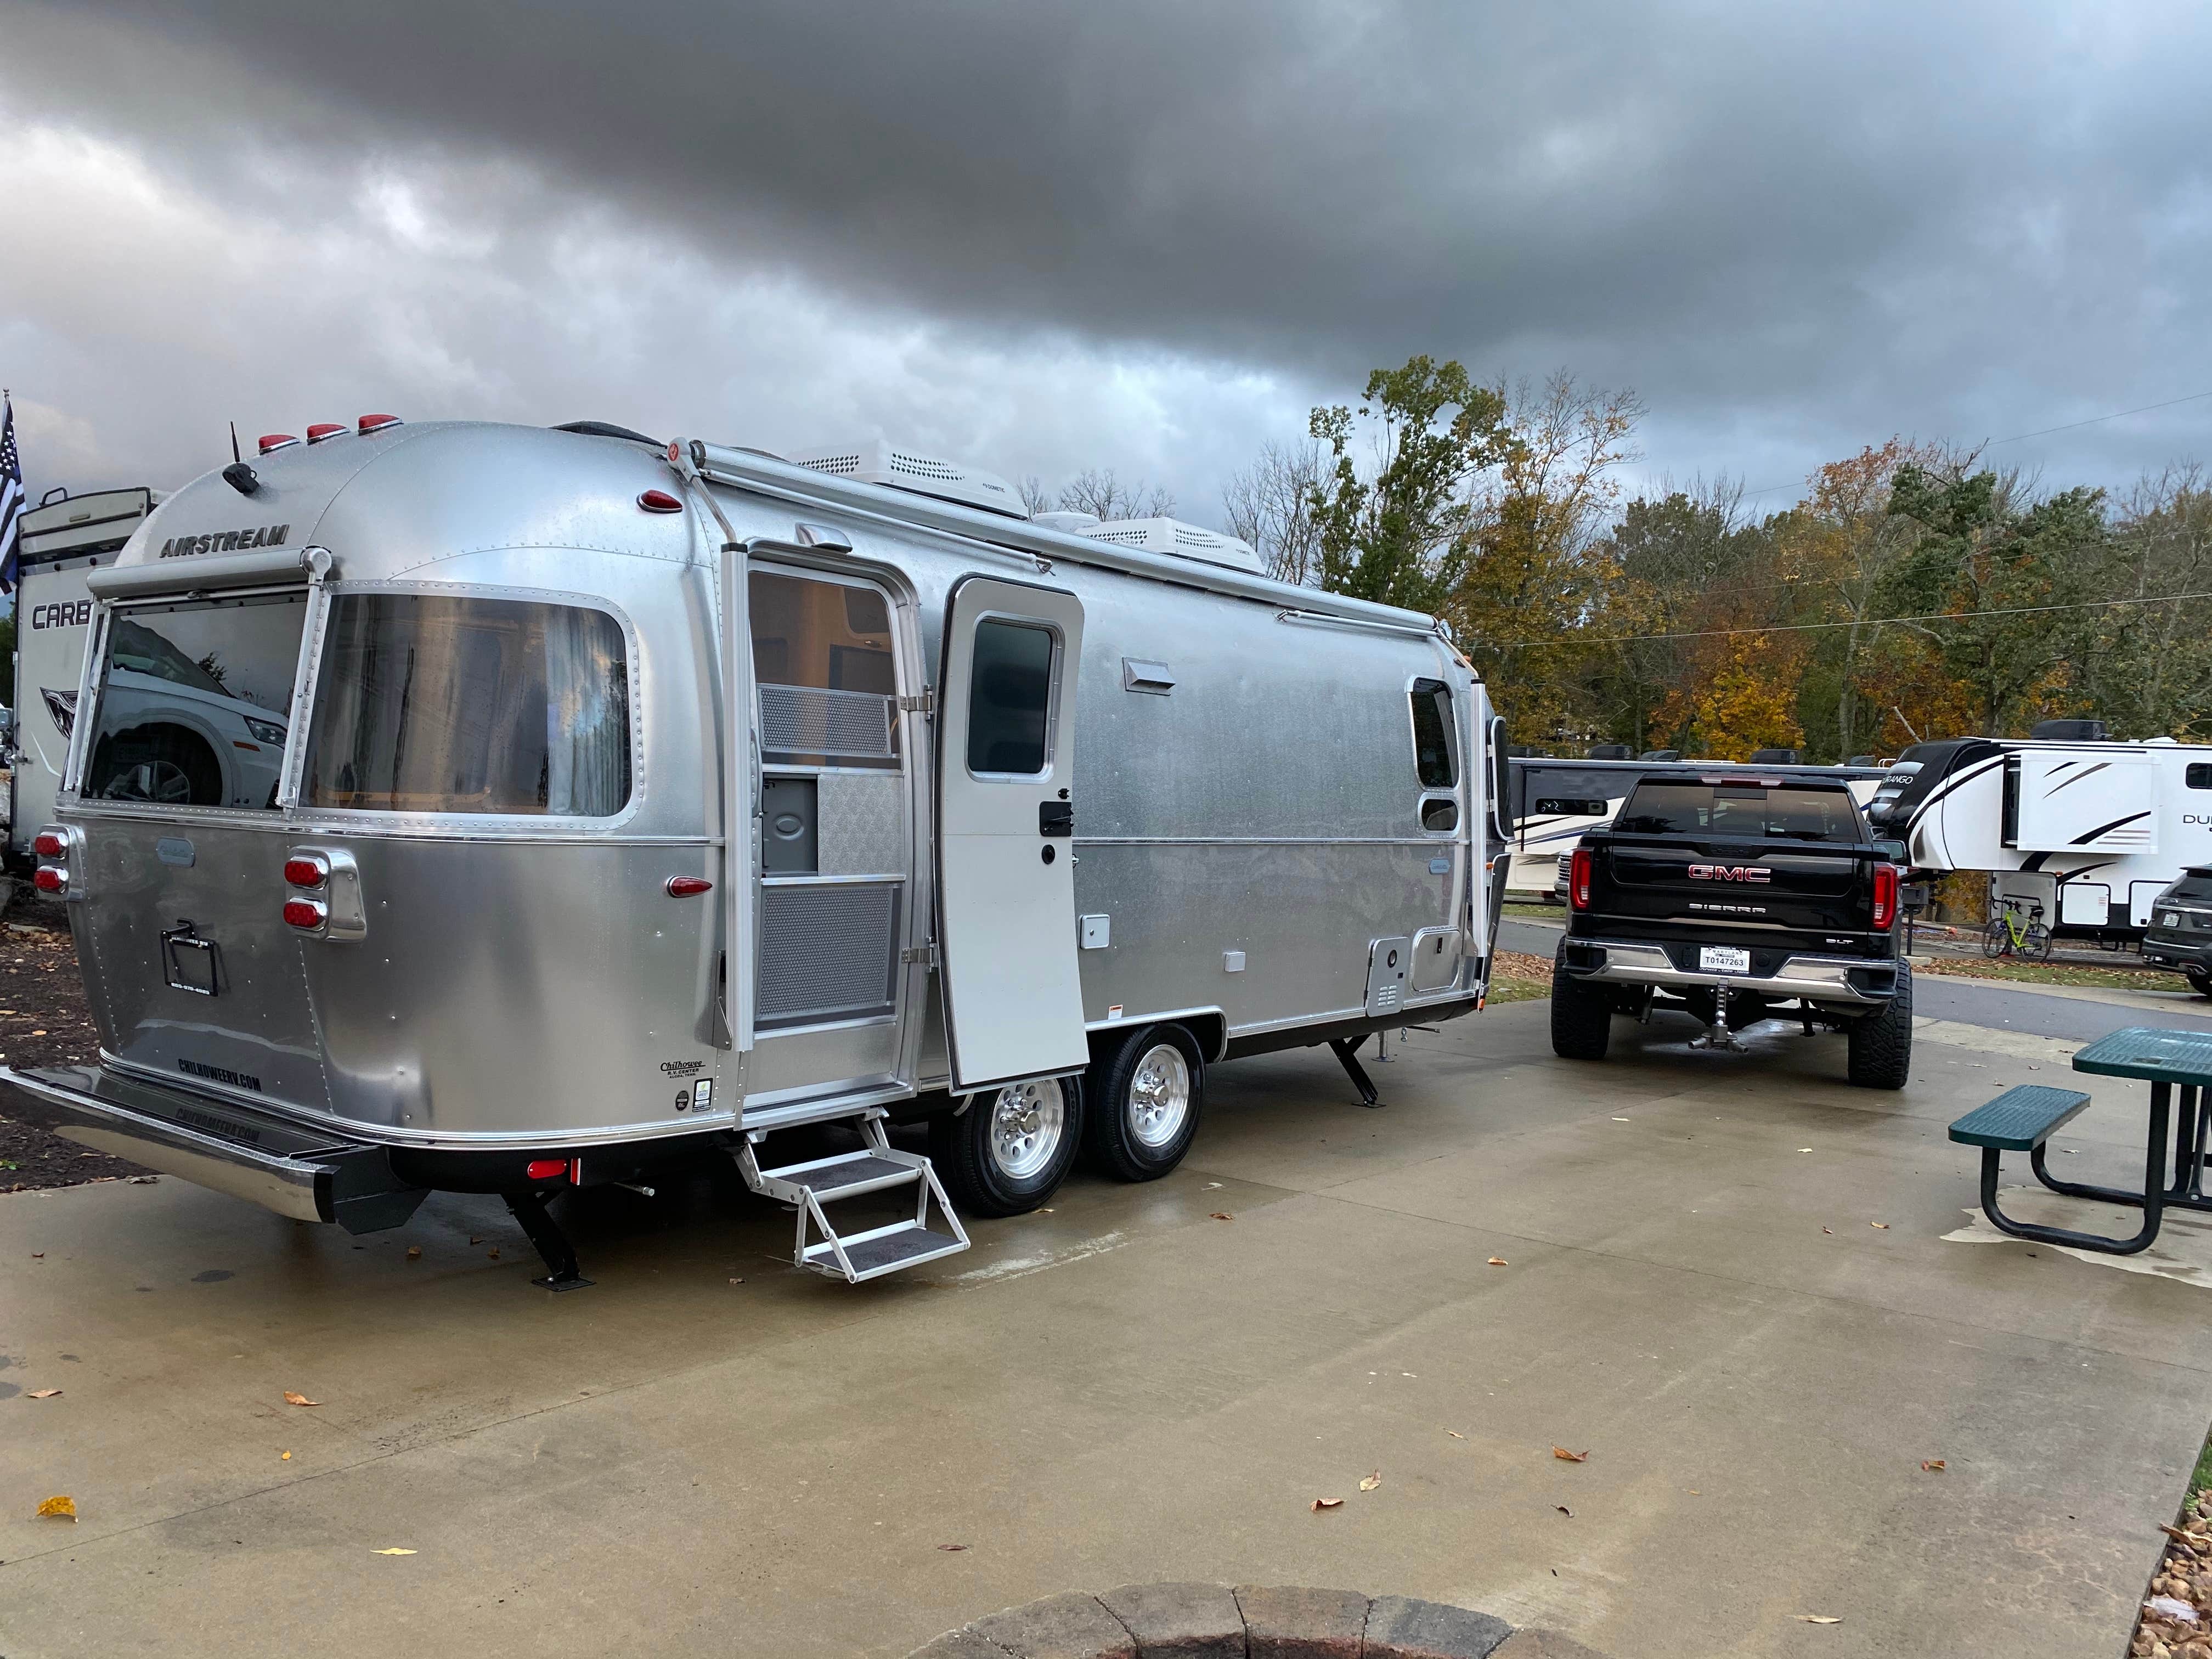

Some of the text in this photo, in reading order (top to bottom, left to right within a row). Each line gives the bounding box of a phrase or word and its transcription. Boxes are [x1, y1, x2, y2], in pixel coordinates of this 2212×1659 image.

[988, 484, 1005, 493] DOMETIC
[159, 524, 290, 558] AIRSTREAM
[1882, 775, 1914, 784] URANGO
[2183, 815, 2212, 824] DU
[1689, 865, 1771, 883] GMC
[1689, 904, 1767, 913] SIERRA
[1705, 957, 1743, 966] T0147263
[660, 1060, 706, 1071] Chilhowee
[178, 1058, 262, 1092] CHILHOWEERV.COM
